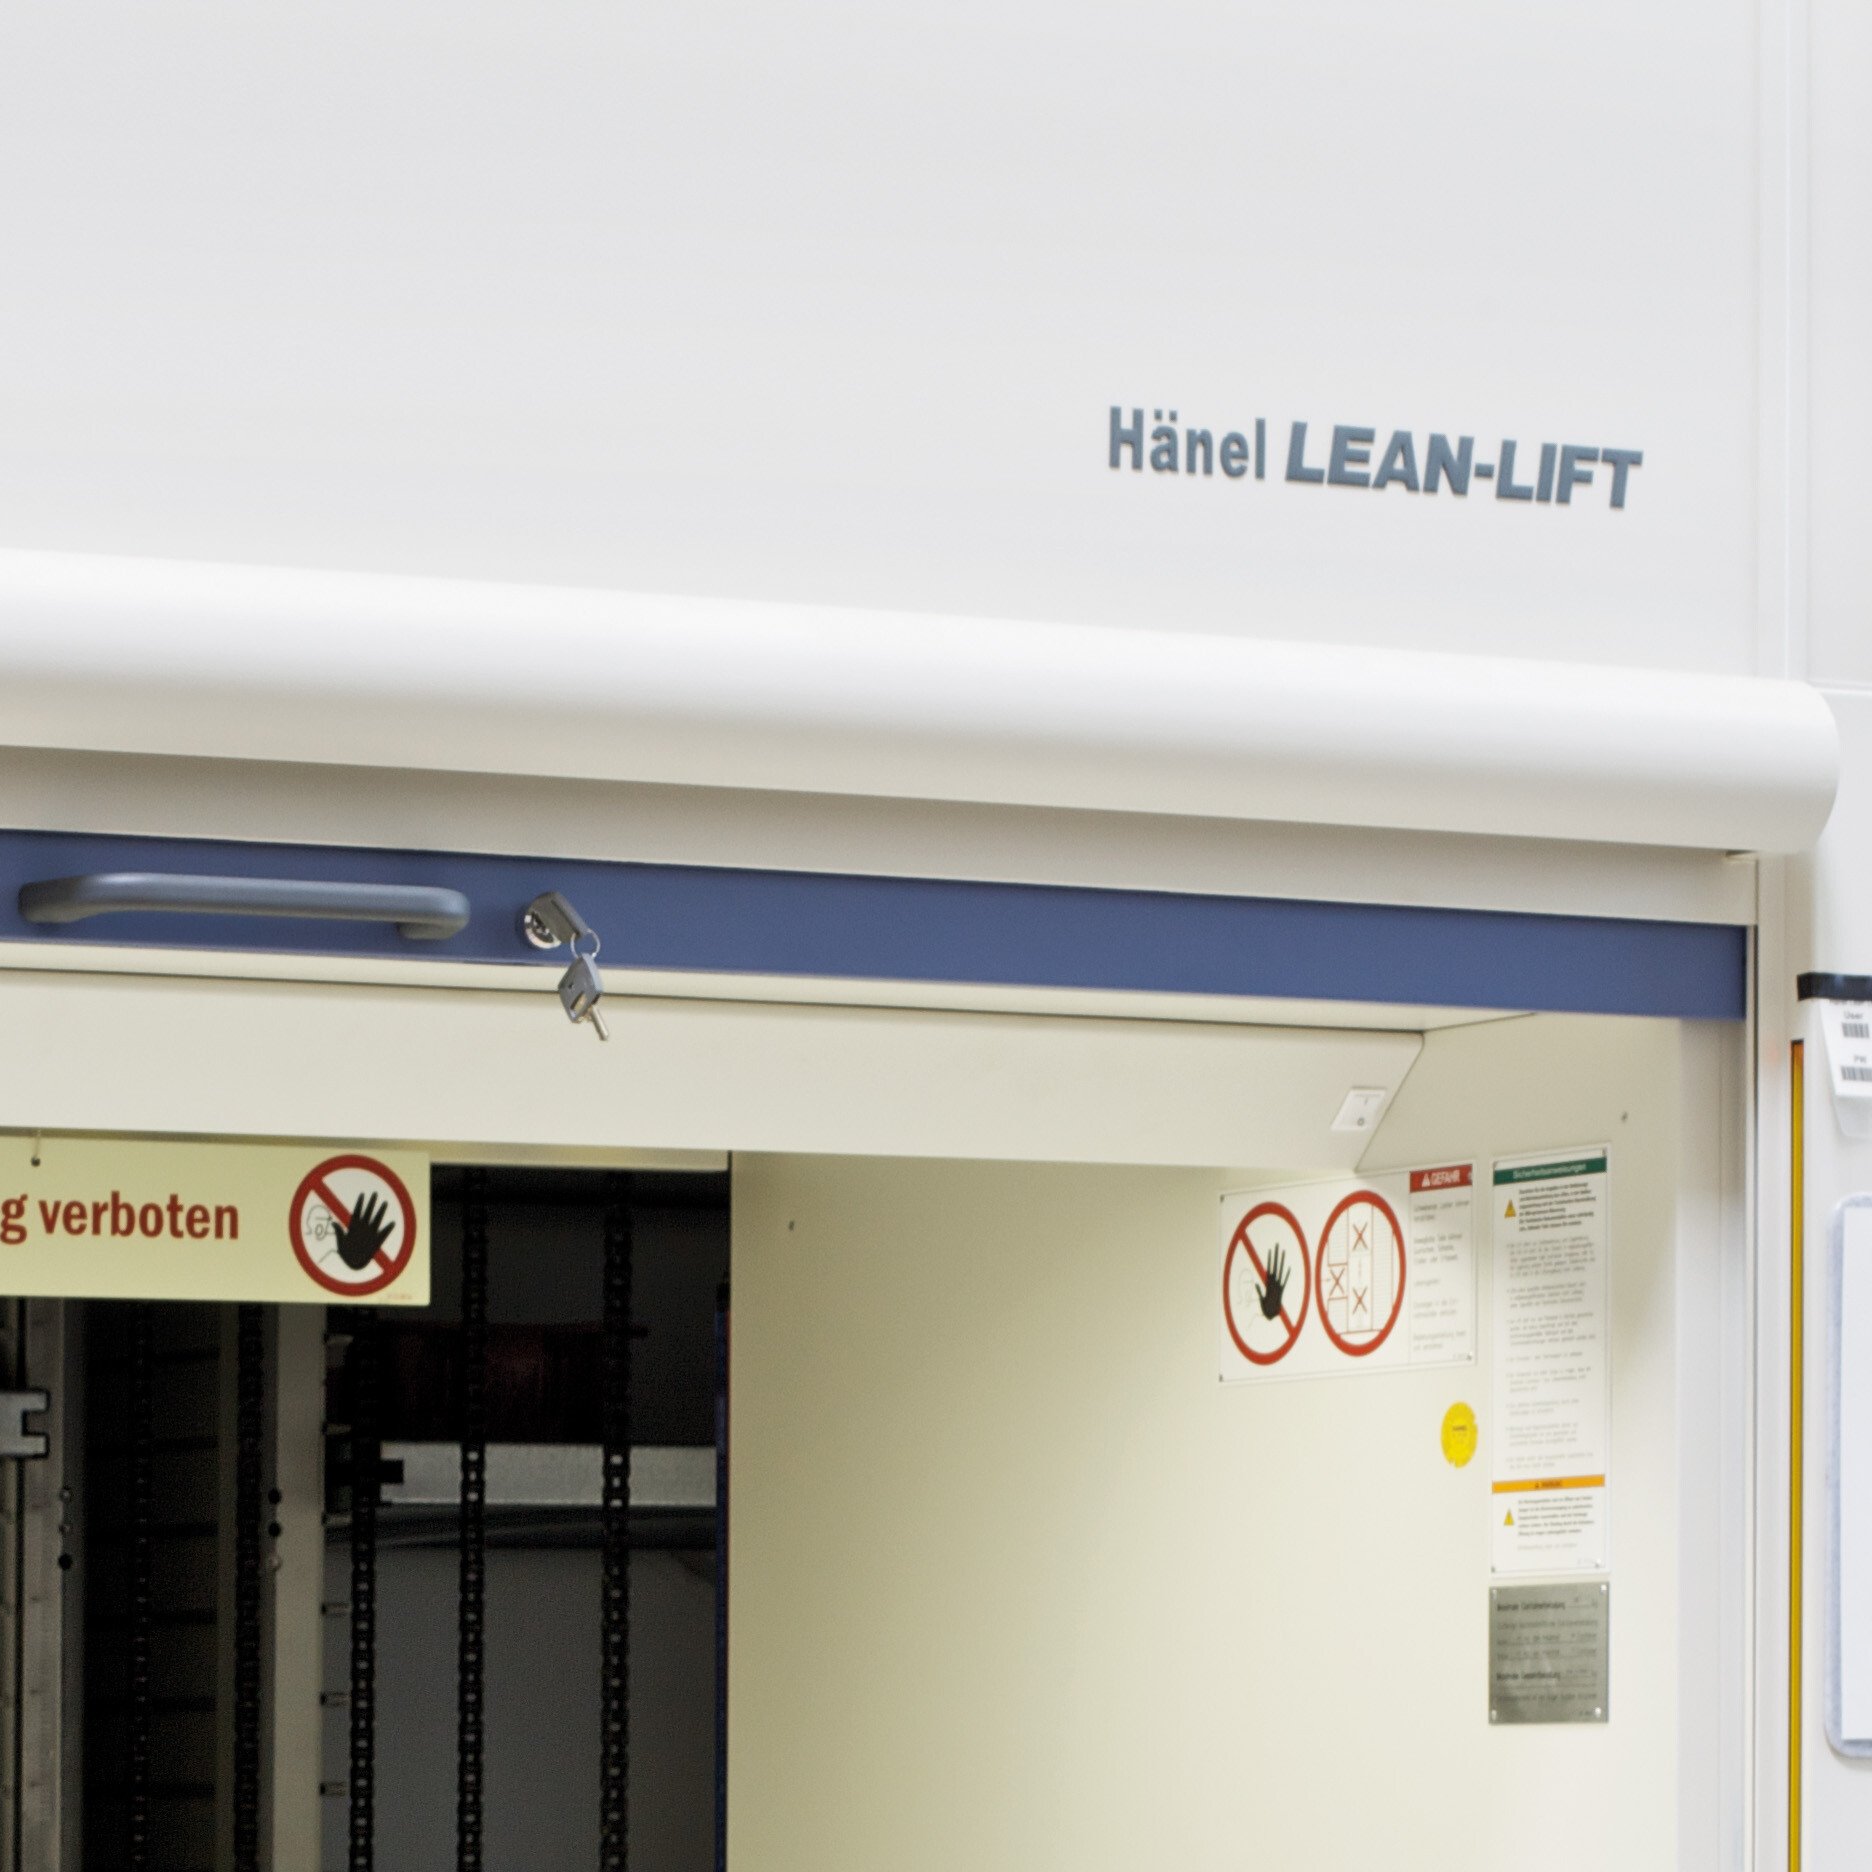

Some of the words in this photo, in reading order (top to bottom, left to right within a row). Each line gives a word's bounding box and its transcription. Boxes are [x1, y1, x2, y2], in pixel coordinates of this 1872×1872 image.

[1108, 405, 1267, 481] Hänel
[1285, 421, 1643, 510] LEAN-LIFT
[39, 1190, 239, 1241] verboten
